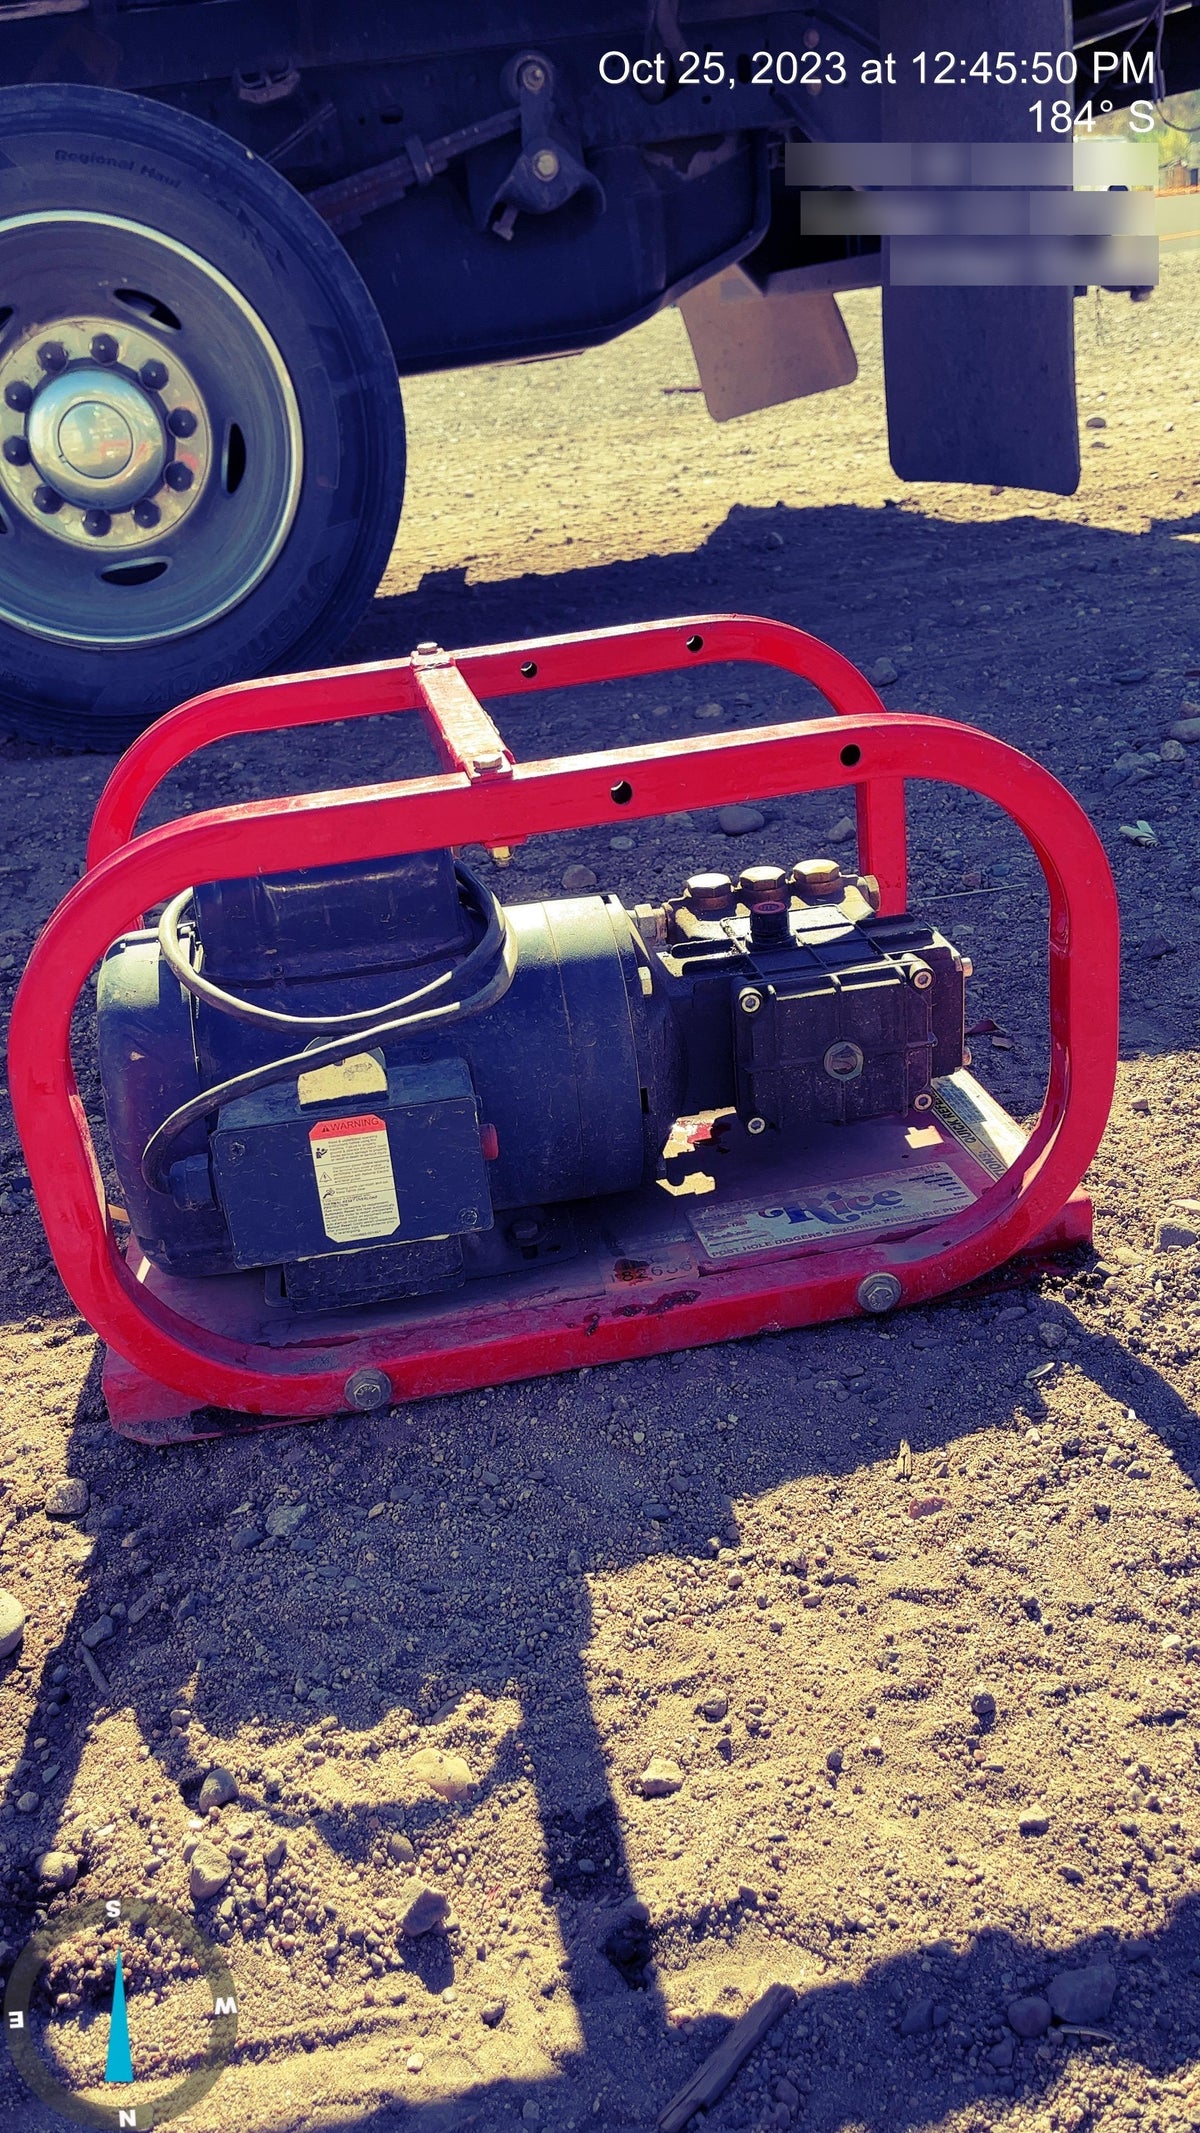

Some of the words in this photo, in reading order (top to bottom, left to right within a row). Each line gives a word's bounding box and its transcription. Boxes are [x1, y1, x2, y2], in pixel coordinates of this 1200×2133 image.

[54, 149, 135, 171] Regional
[140, 164, 182, 189] Haul
[329, 1117, 379, 1131] WARNING
[947, 1117, 977, 1143] QUICK
[757, 1189, 903, 1225] Rice
[742, 1241, 773, 1251] HOLE
[775, 1231, 823, 1245] DIGGERS
